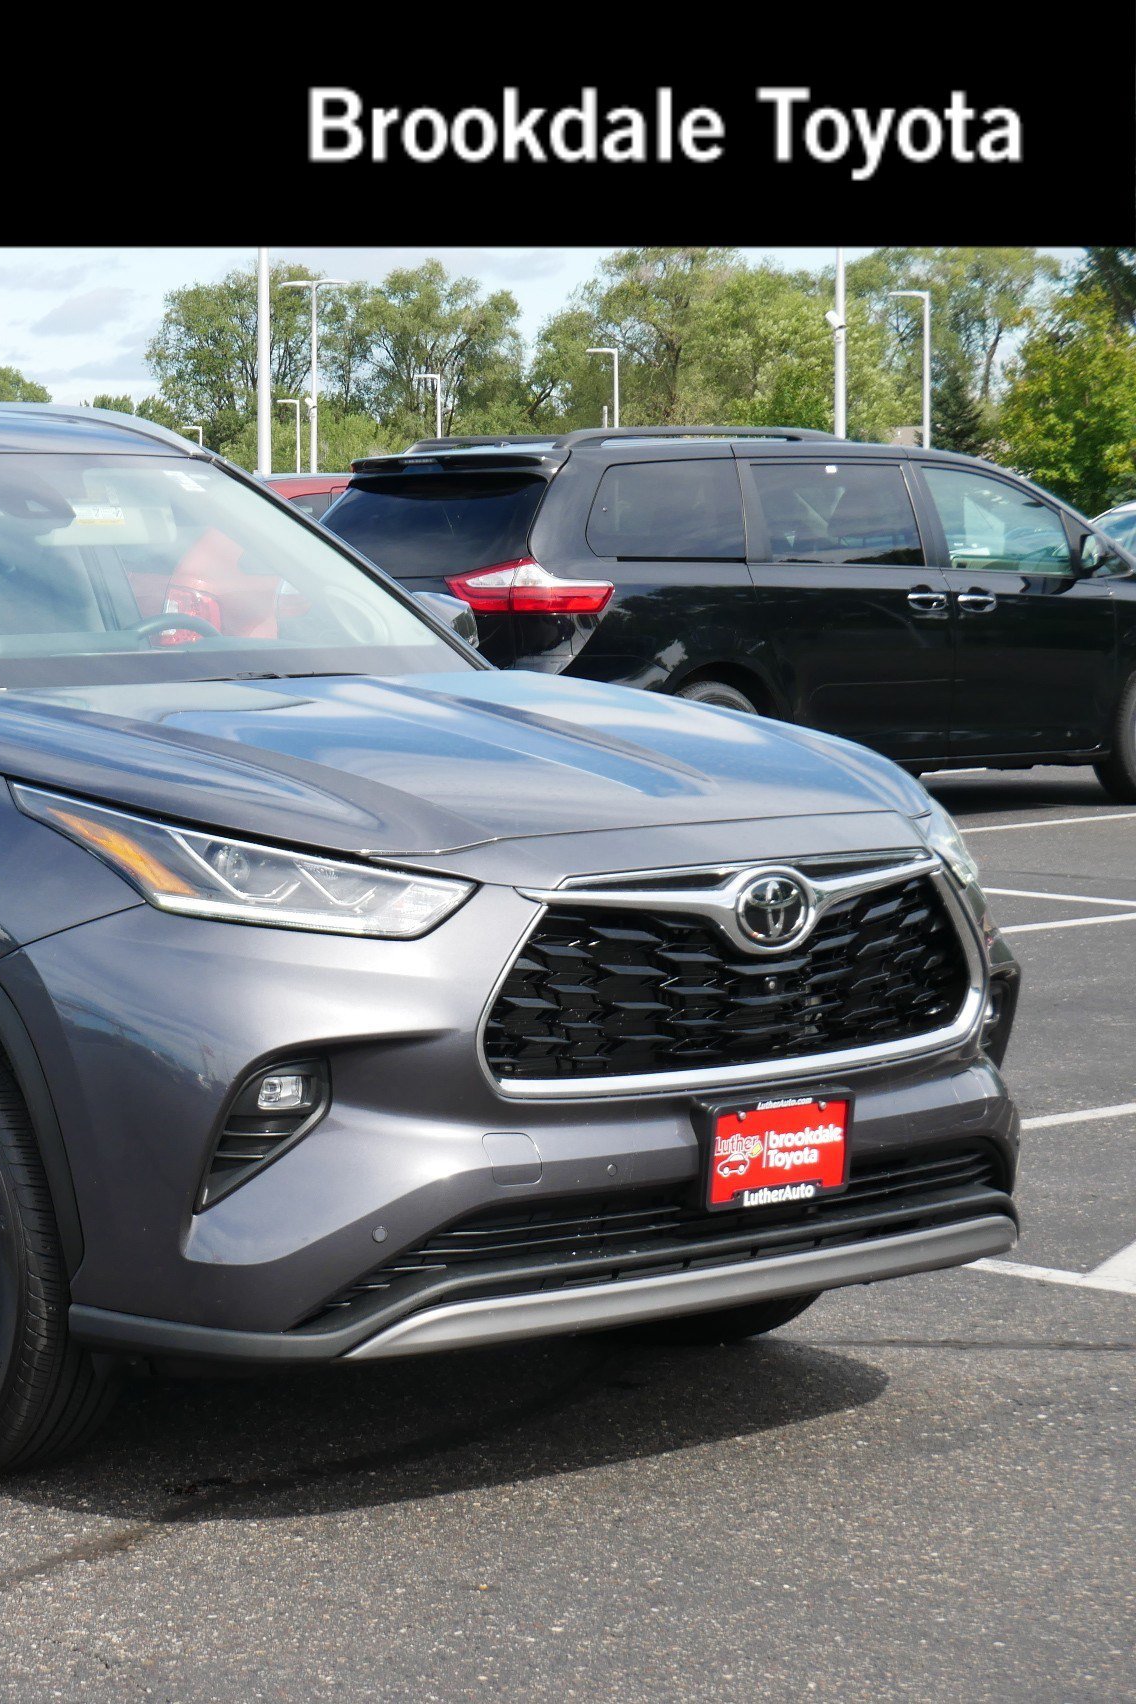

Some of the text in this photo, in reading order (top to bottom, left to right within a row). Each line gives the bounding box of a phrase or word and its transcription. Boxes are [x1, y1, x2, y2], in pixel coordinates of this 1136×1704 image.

[715, 1133, 760, 1156] Luther
[769, 1123, 843, 1147] brookdale
[768, 1147, 818, 1169] Toyota
[743, 1184, 815, 1206] LutherAuto
